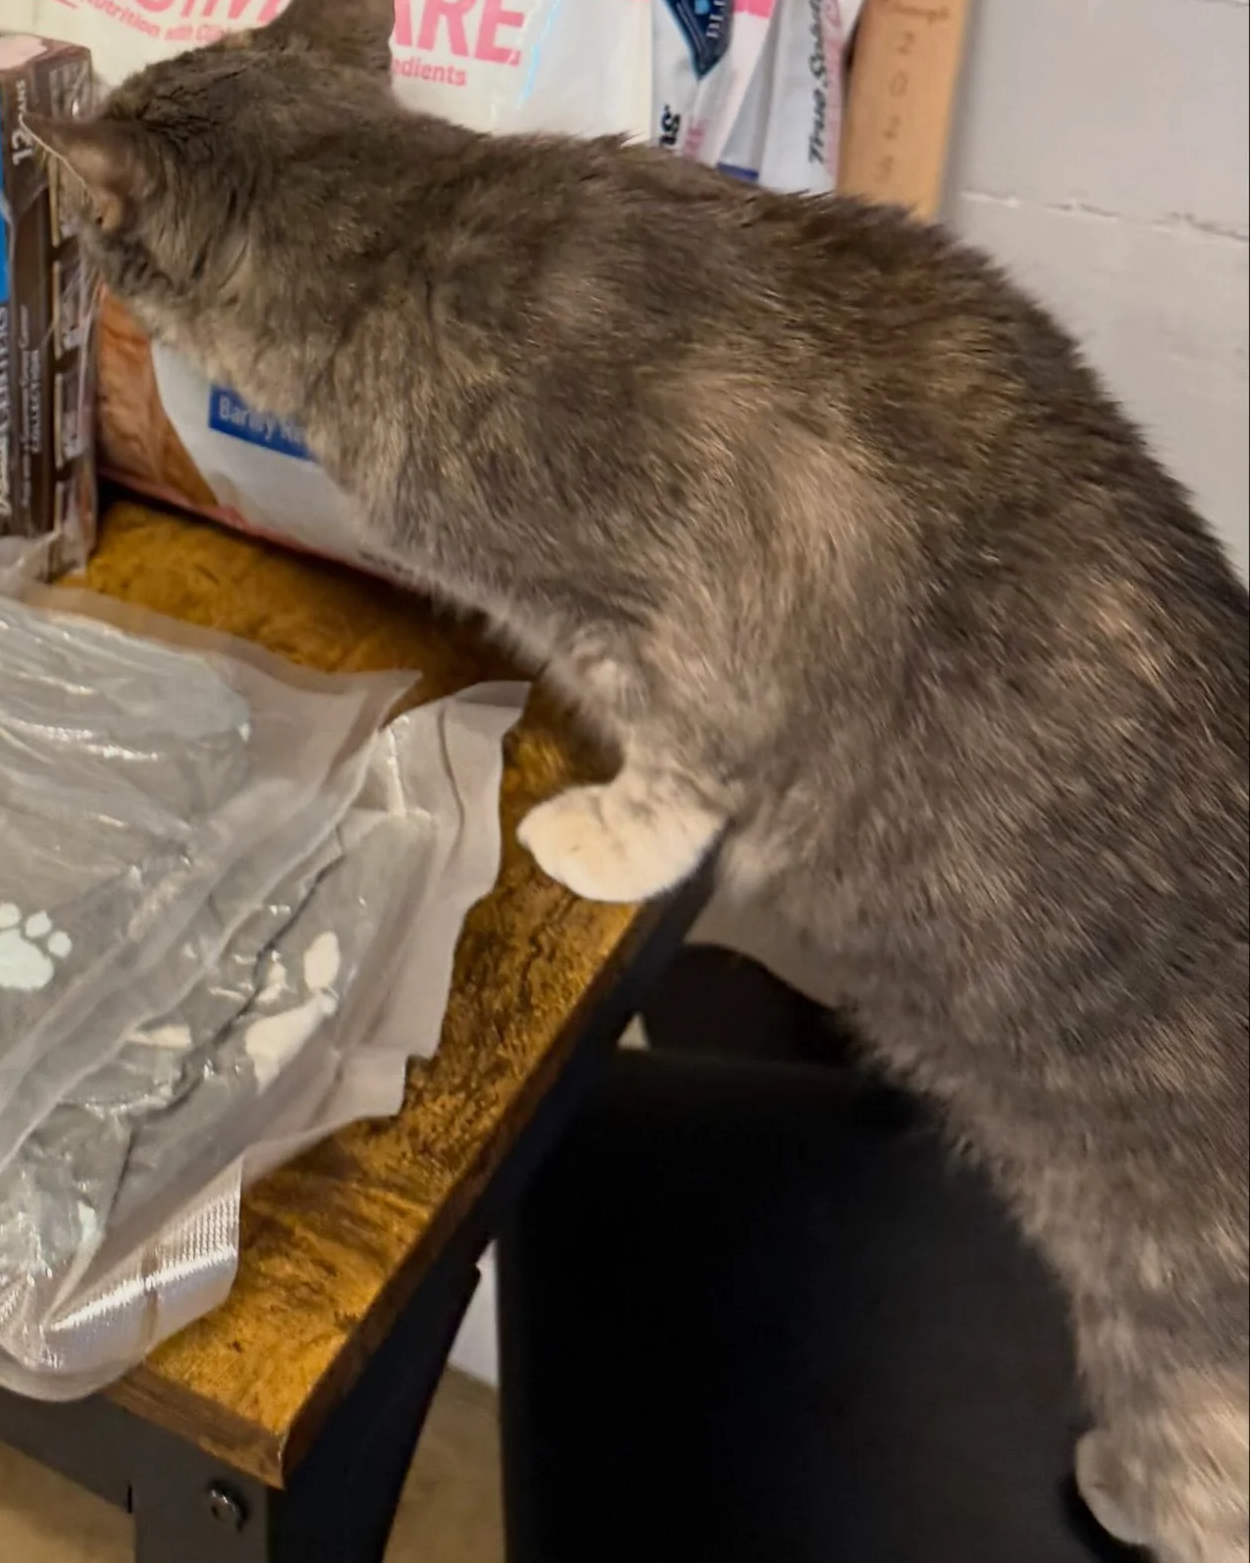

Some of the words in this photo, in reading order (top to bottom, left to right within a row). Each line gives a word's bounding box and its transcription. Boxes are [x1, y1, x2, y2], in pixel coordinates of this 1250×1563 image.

[392, 55, 468, 87] edients
[807, 89, 829, 165] True
[11, 129, 32, 166] 12
